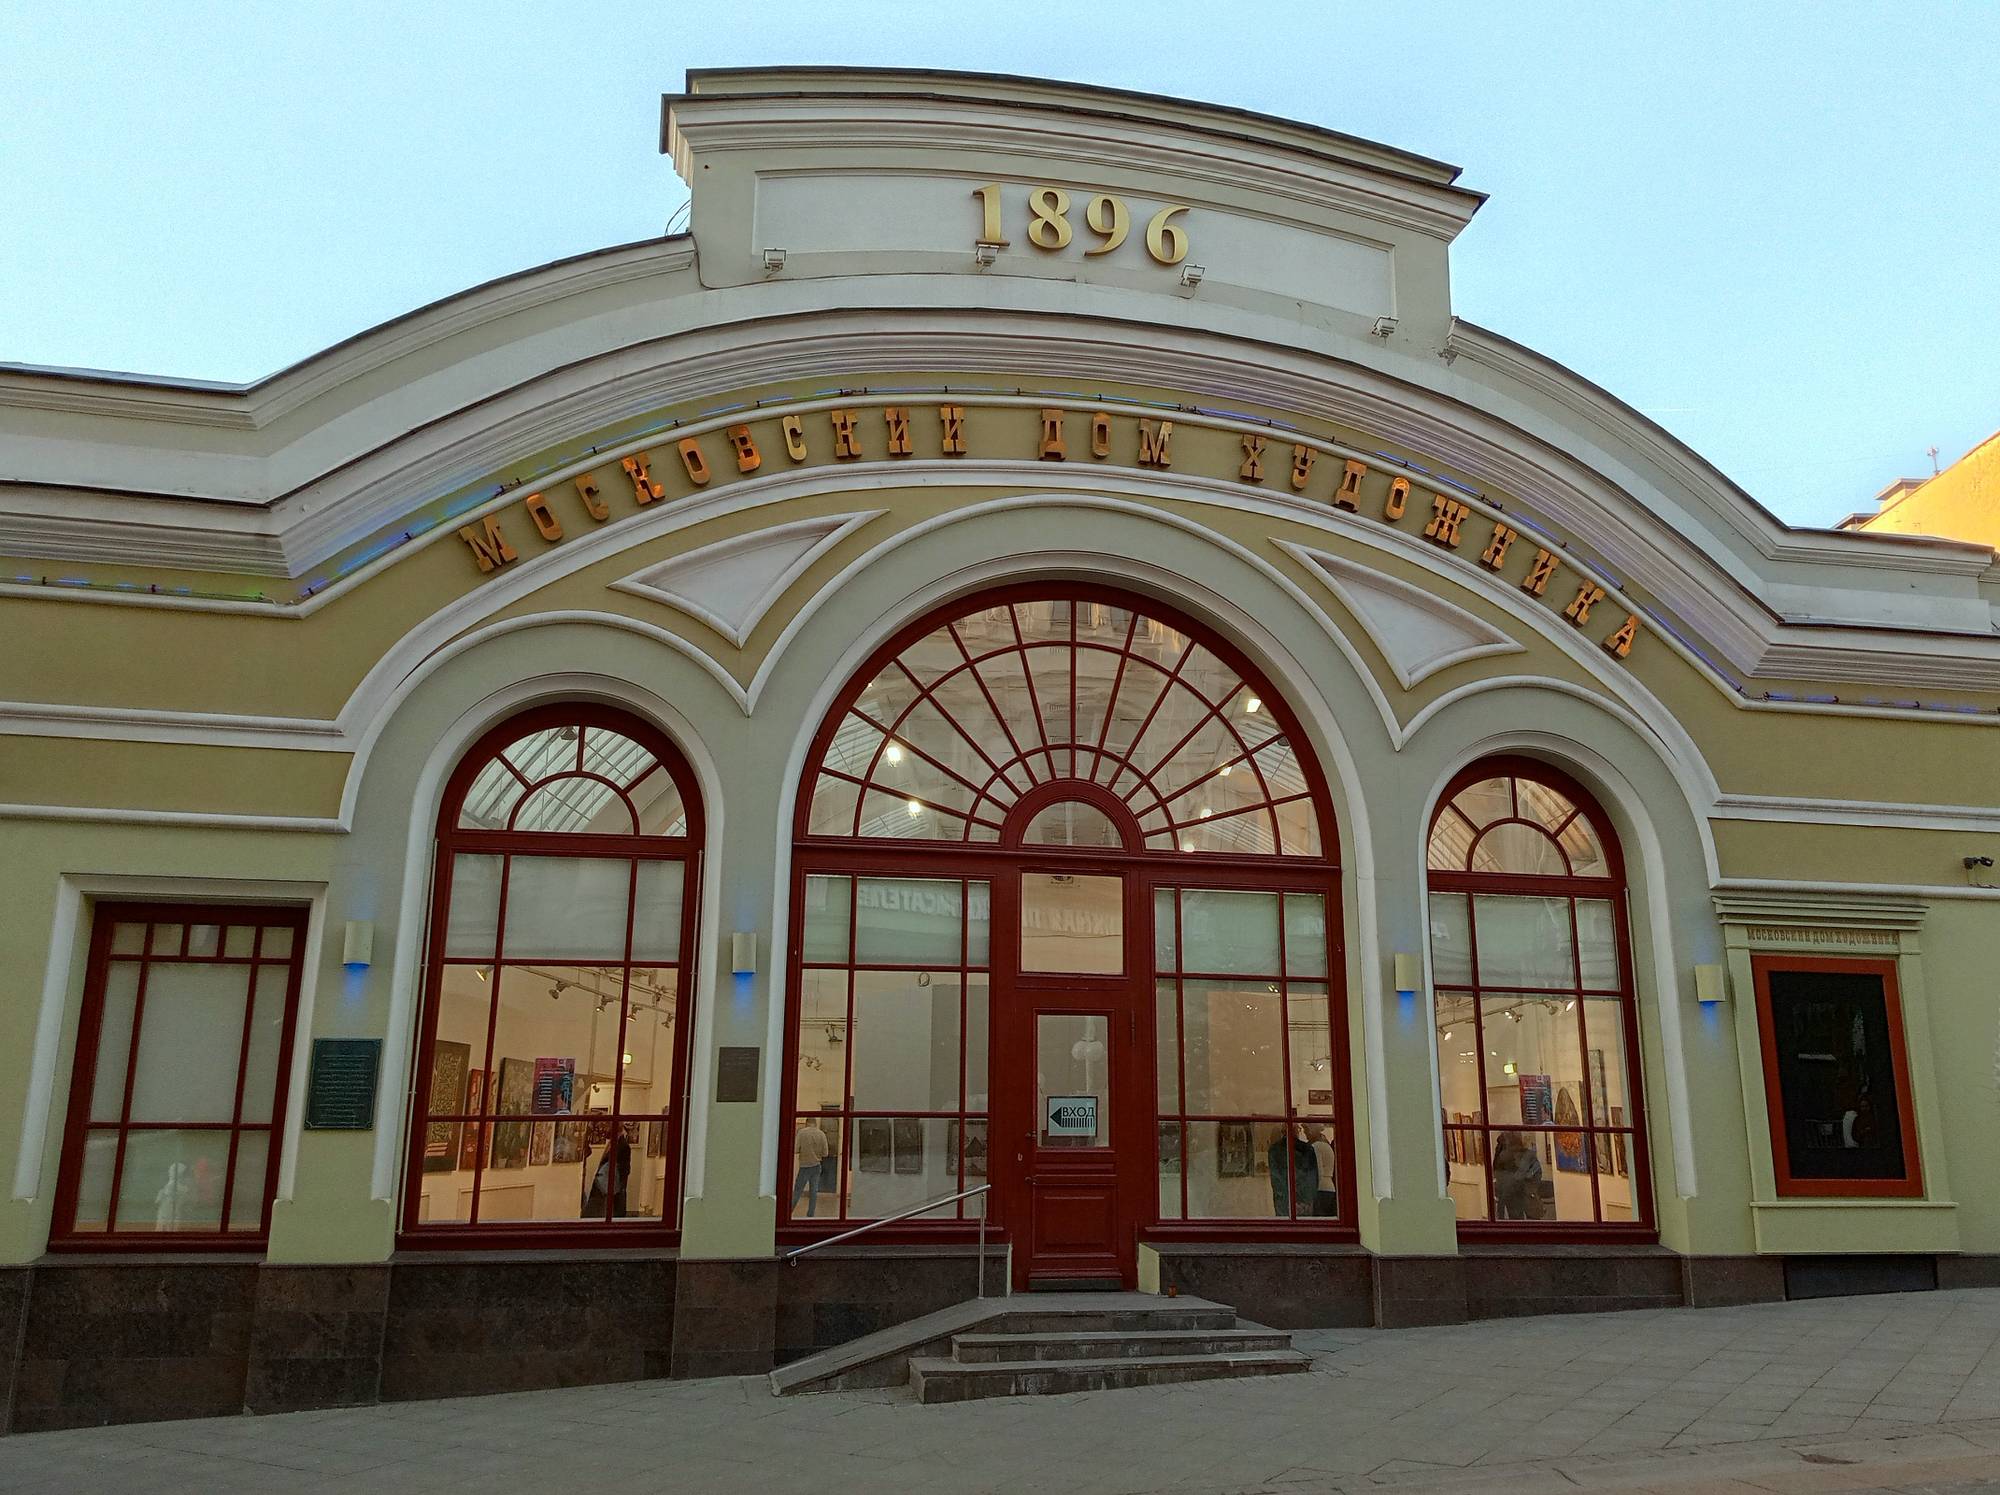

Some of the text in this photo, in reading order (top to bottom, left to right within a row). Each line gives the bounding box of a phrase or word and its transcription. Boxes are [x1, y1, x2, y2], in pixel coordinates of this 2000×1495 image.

[973, 182, 1191, 265] 1896
[1038, 408, 1173, 467] ДОМ
[1240, 433, 1640, 660] ХУДОЖНИКА
[1062, 1106, 1095, 1119] ВХОД
